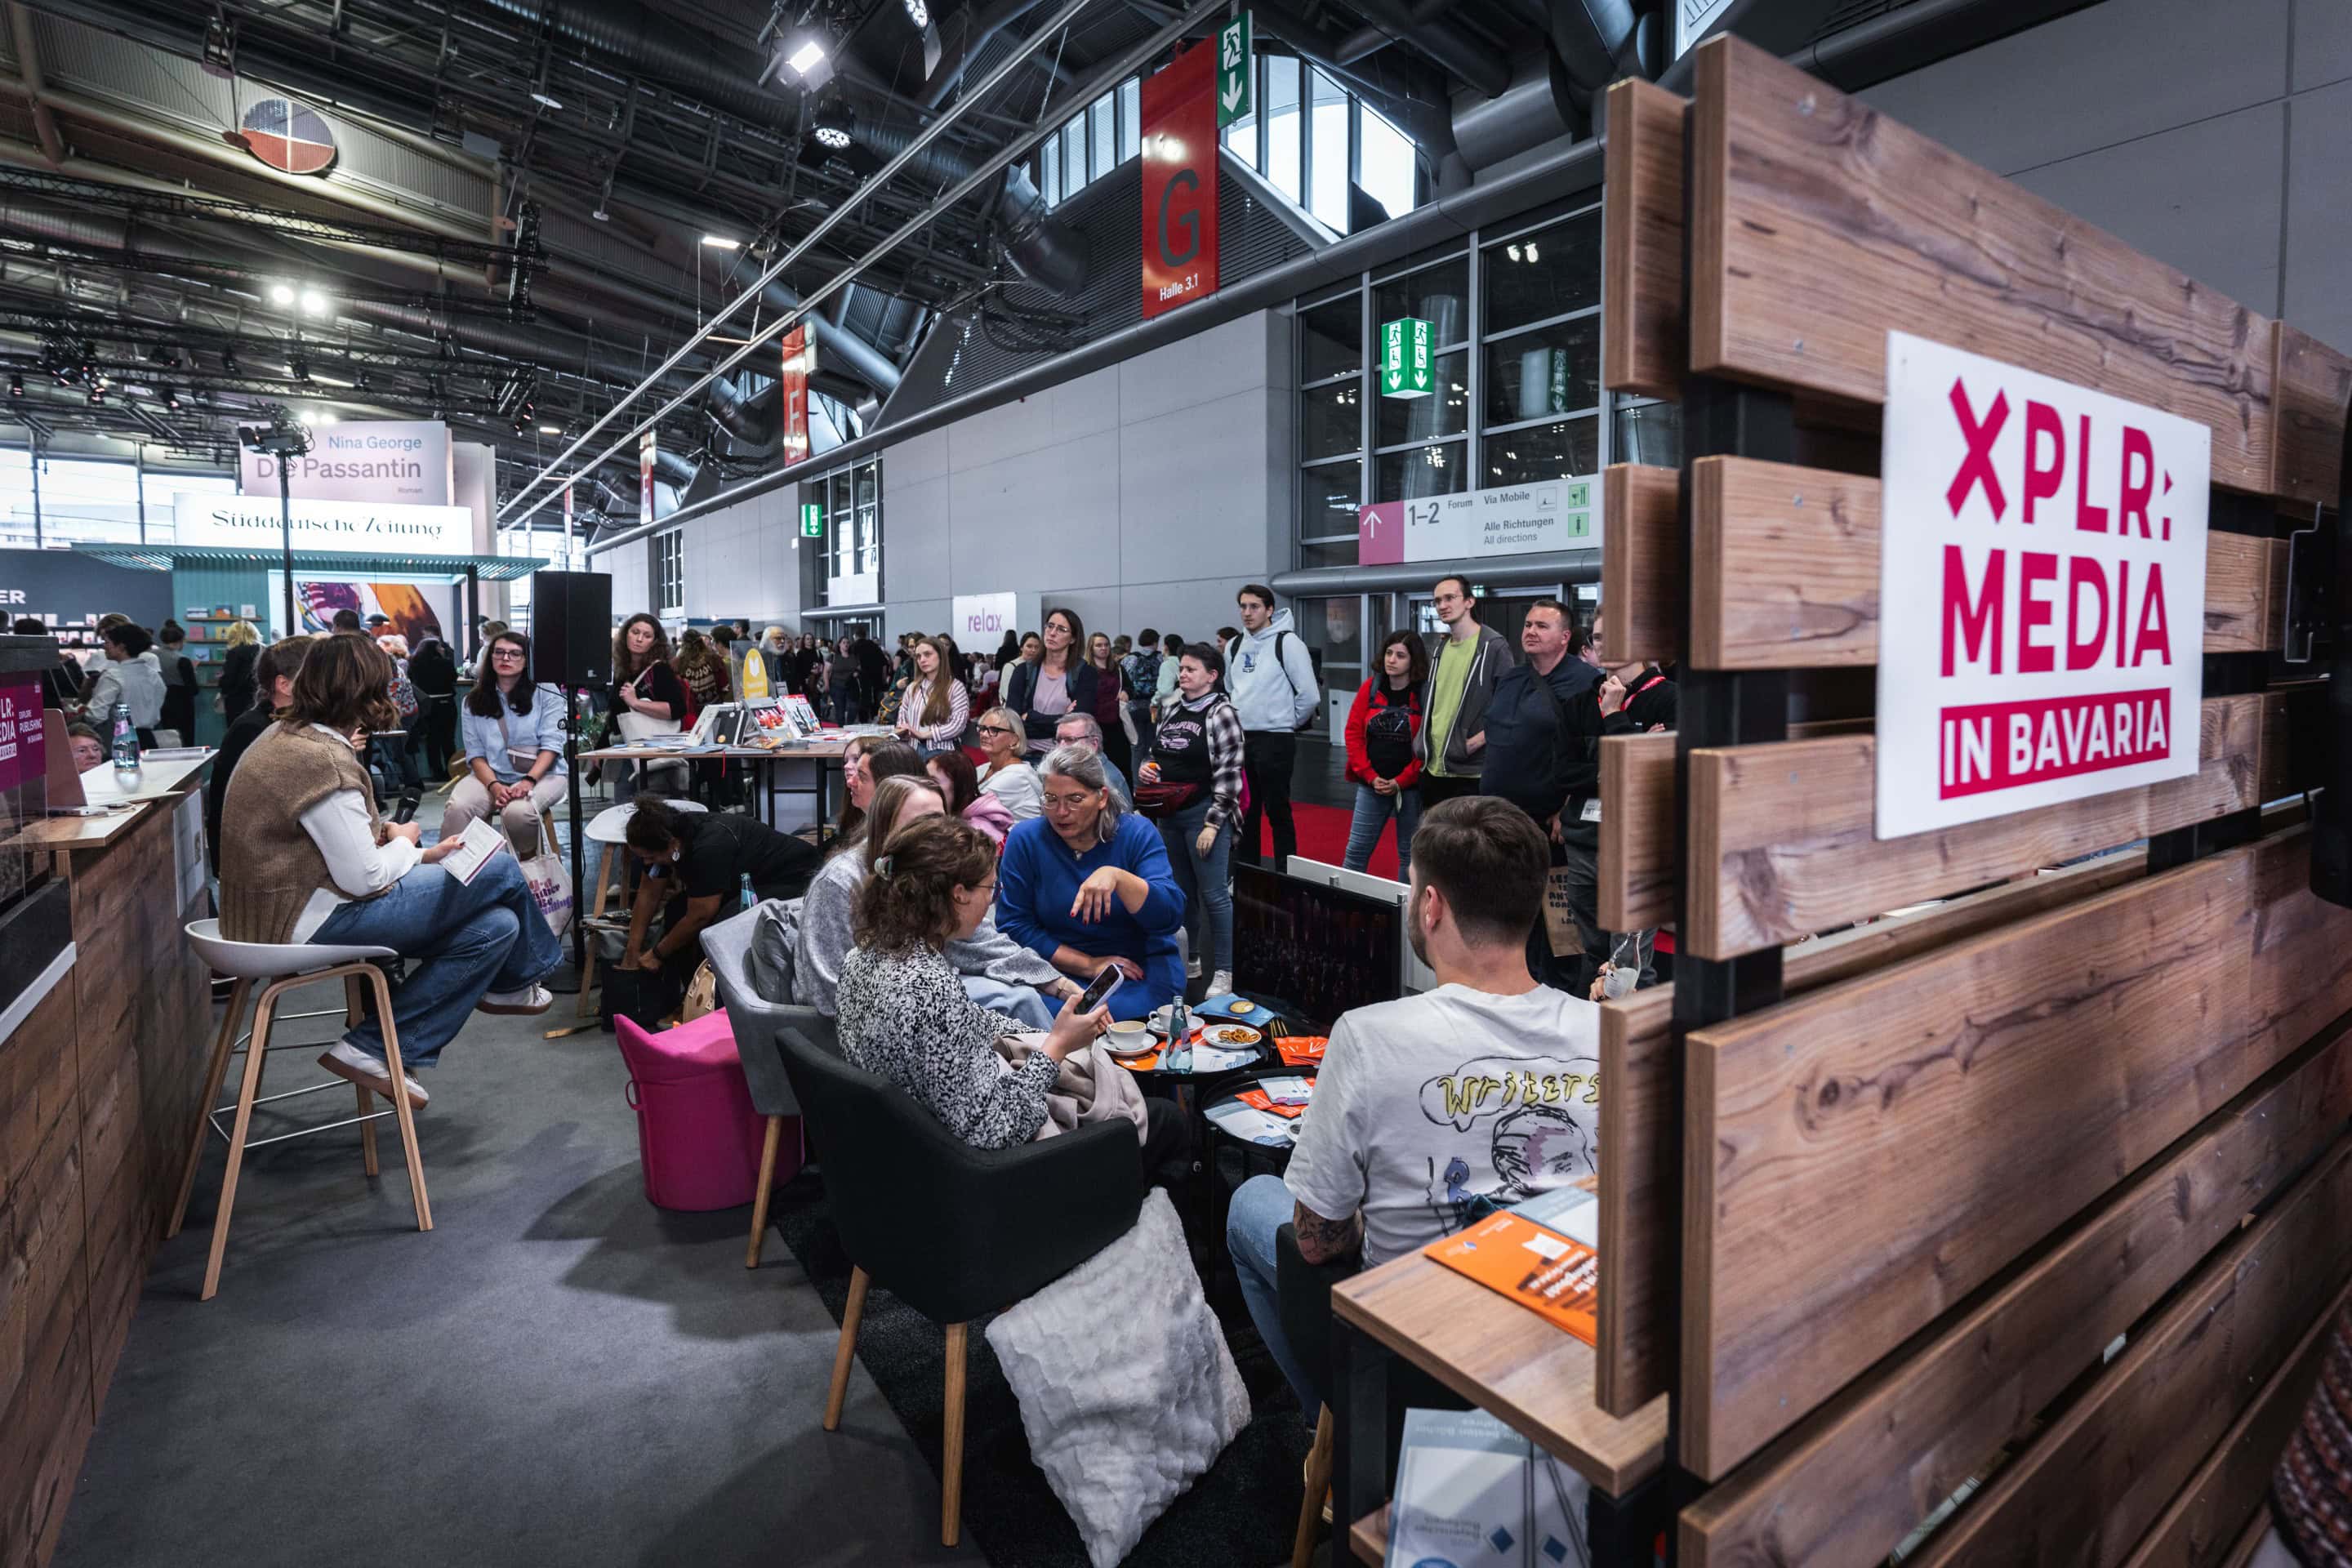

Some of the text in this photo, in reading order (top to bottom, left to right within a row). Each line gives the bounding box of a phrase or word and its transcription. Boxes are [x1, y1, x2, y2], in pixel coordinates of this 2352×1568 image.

[1158, 168, 1200, 268] G
[1160, 273, 1199, 301] Halle 3.1
[328, 436, 422, 452] Nina George
[304, 457, 421, 478] Passantin
[1945, 376, 2173, 541] XPLR:
[1448, 498, 1472, 510] Forum
[1484, 491, 1530, 505] Via Mobile
[365, 517, 443, 541] Zeitung
[1484, 516, 1554, 532] Alle Richtungen
[1484, 532, 1537, 545] All directions
[968, 608, 1003, 633] relax
[1940, 544, 2172, 678] MEDIA
[1943, 698, 2167, 786] IN BAVARIA
[1437, 1071, 1600, 1119] Writers
